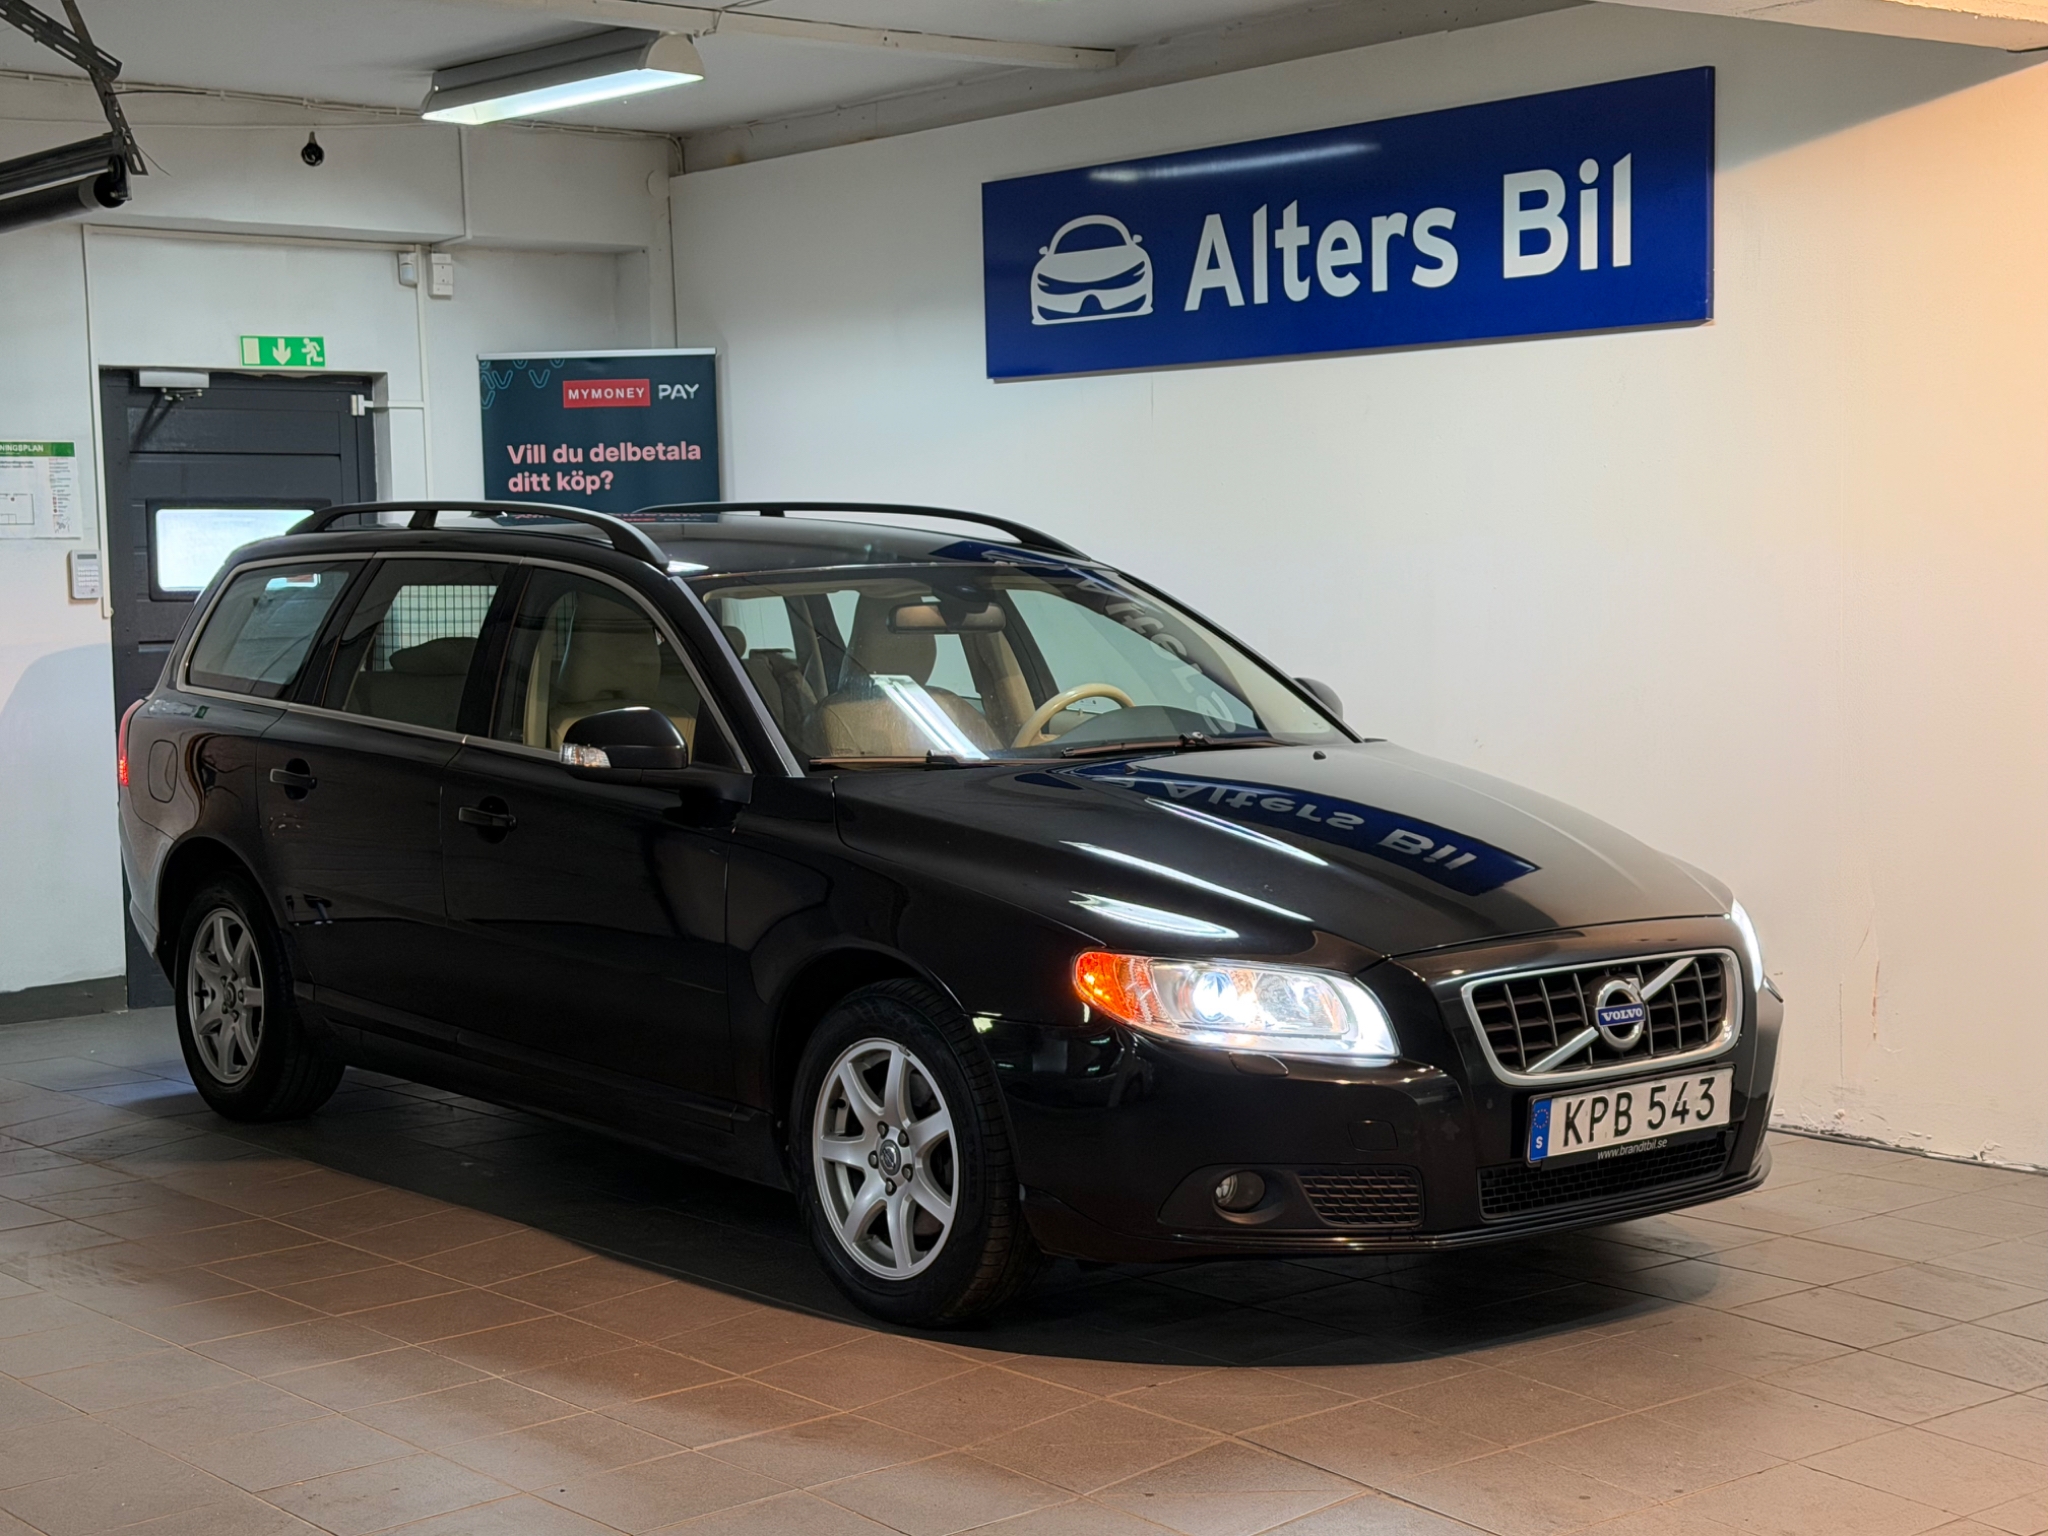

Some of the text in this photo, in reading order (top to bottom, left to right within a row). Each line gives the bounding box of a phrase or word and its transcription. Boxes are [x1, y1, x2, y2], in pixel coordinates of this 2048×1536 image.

[1184, 152, 1632, 311] Alters Bil
[568, 383, 699, 400] MYMONEY PAY
[507, 441, 702, 464] Vill du delbetala
[508, 470, 614, 495] ditt köp?
[1601, 1007, 1643, 1022] VOLVO
[1563, 1076, 1716, 1147] KPB 543
[1535, 1135, 1543, 1150] S
[1597, 1137, 1668, 1160] www.brandtbil.se
